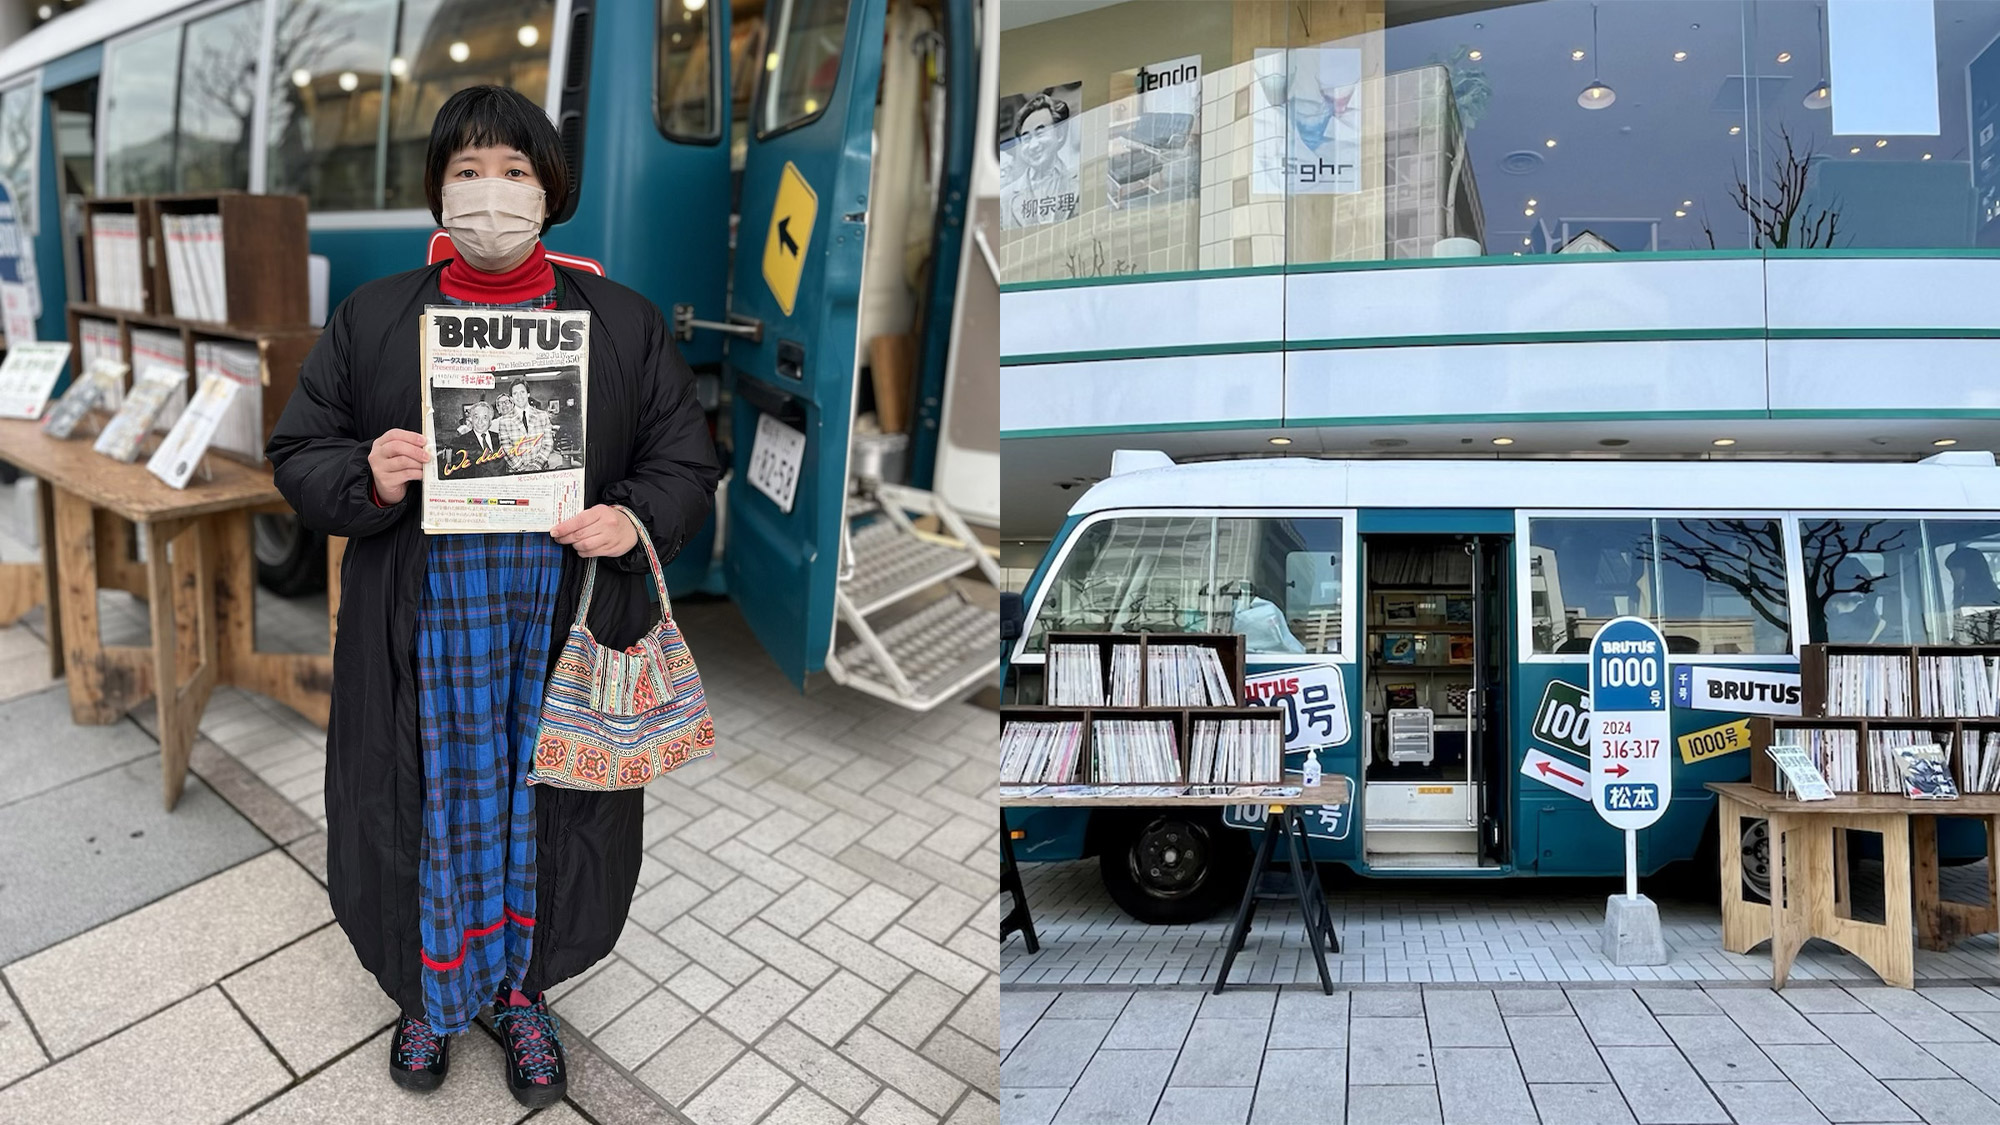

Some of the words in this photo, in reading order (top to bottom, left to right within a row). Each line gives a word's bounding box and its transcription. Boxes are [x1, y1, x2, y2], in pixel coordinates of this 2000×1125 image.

[1021, 192, 1076, 219] 柳宗理
[433, 314, 585, 351] BRUTUS
[444, 449, 472, 476] We
[1602, 640, 1657, 654] BRUTUS
[1601, 657, 1657, 688] 1000
[1650, 690, 1662, 708] 号
[1707, 679, 1801, 705] BRUTUS
[1603, 721, 1631, 735] 2024
[1603, 740, 1660, 758] 3.16-3.17
[1688, 727, 1739, 758] 1000号
[1609, 786, 1655, 809] 松本
